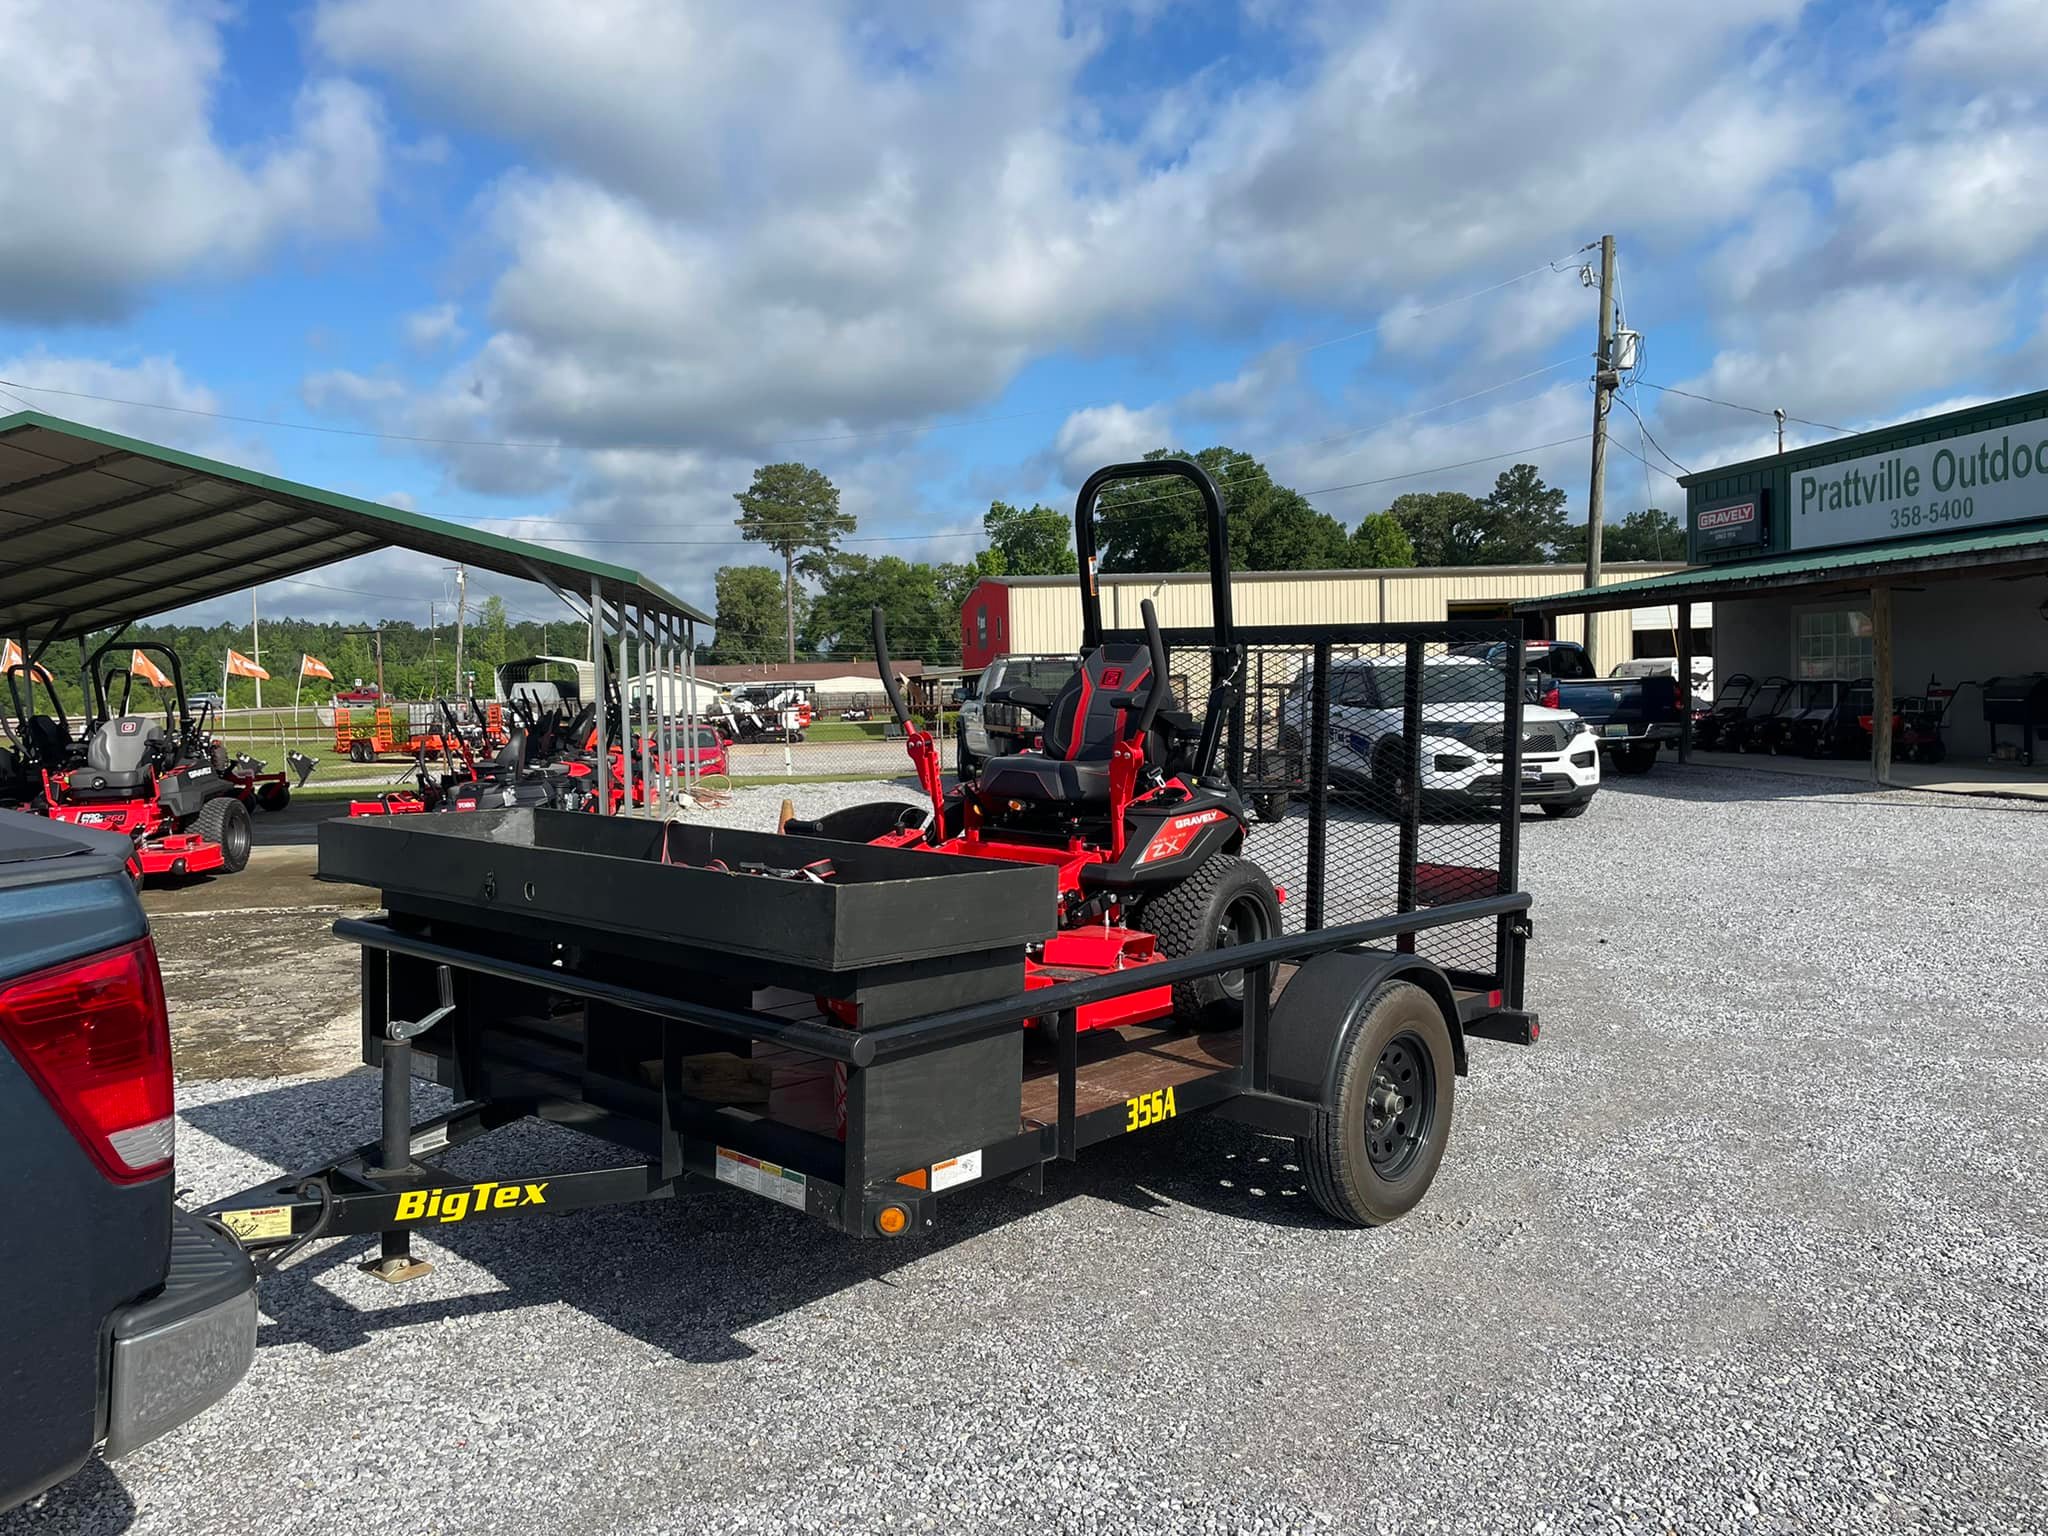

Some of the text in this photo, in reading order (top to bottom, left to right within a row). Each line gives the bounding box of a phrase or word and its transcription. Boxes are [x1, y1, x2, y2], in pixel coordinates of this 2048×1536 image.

[1801, 458, 1920, 515] Prattville
[1700, 507, 1752, 526] GRAVELY
[1890, 497, 1973, 529] 358-5400
[1175, 810, 1217, 829] GRAVELY
[1152, 839, 1180, 858] ZX
[394, 1182, 549, 1223] BigTex
